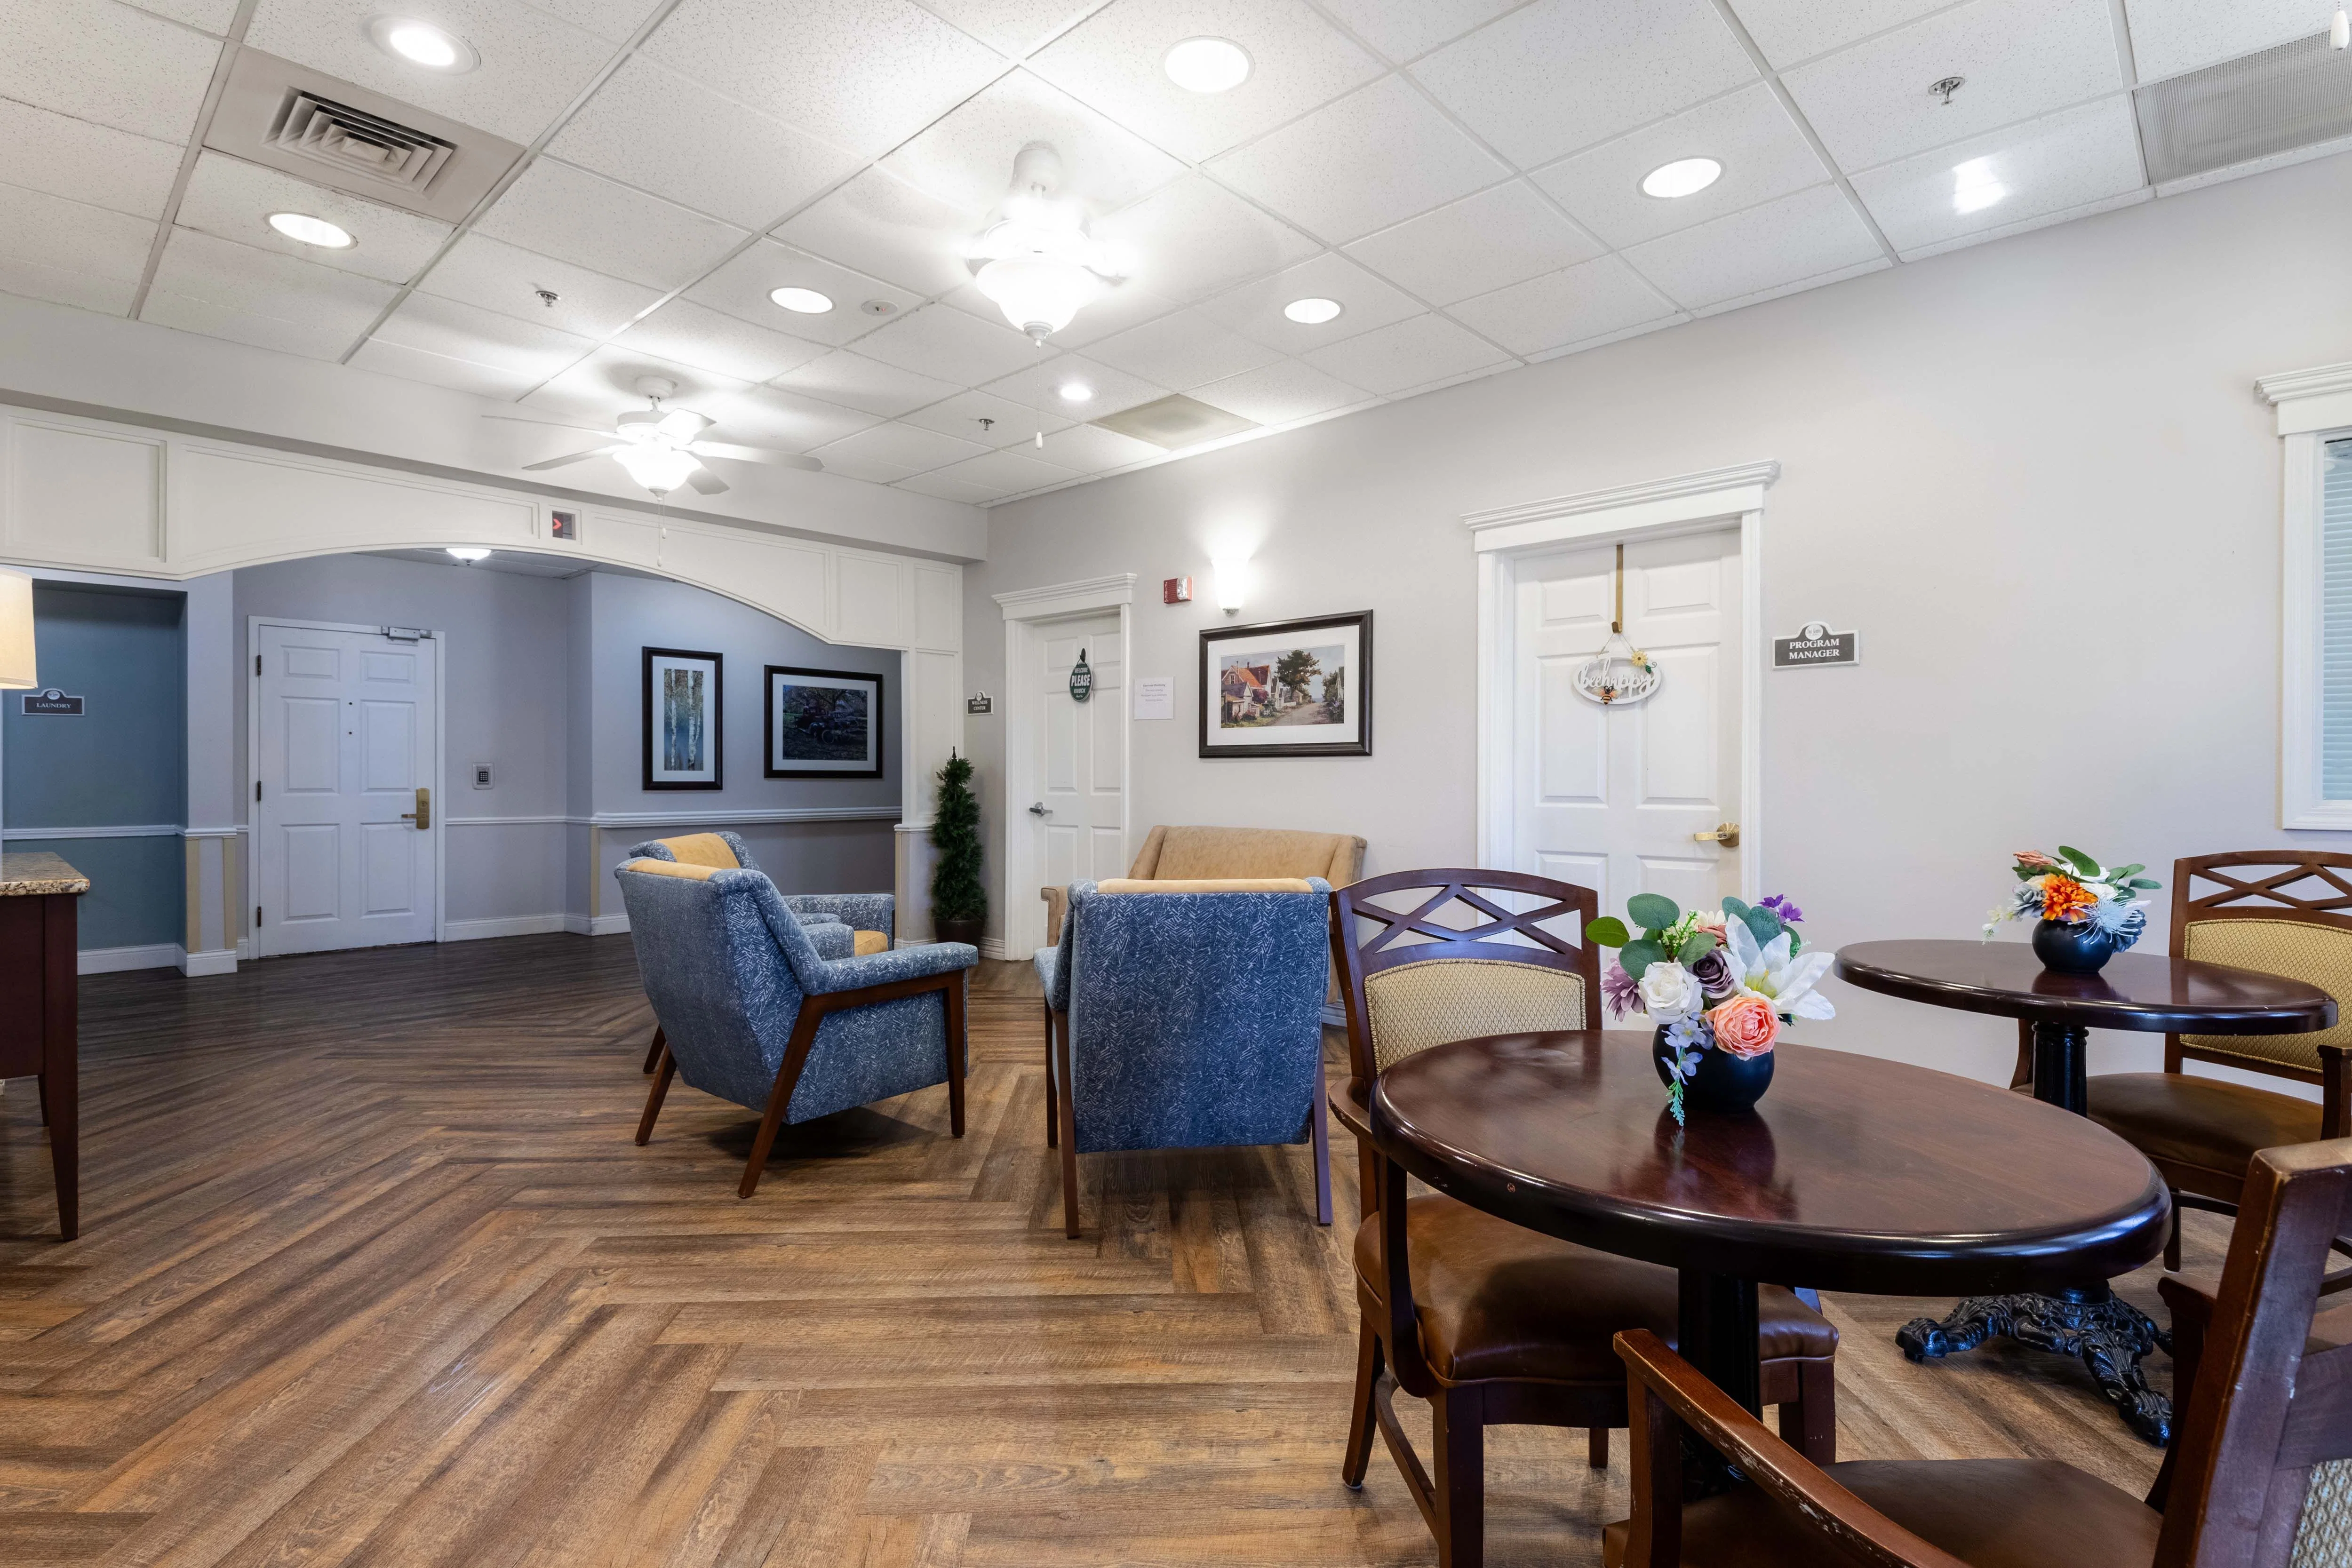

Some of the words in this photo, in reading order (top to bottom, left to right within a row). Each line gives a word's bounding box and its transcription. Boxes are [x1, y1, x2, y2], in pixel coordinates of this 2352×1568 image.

[1789, 638, 1840, 649] PROGRAM
[1789, 649, 1840, 659] MANAGER
[1071, 674, 1090, 687] PLEASE
